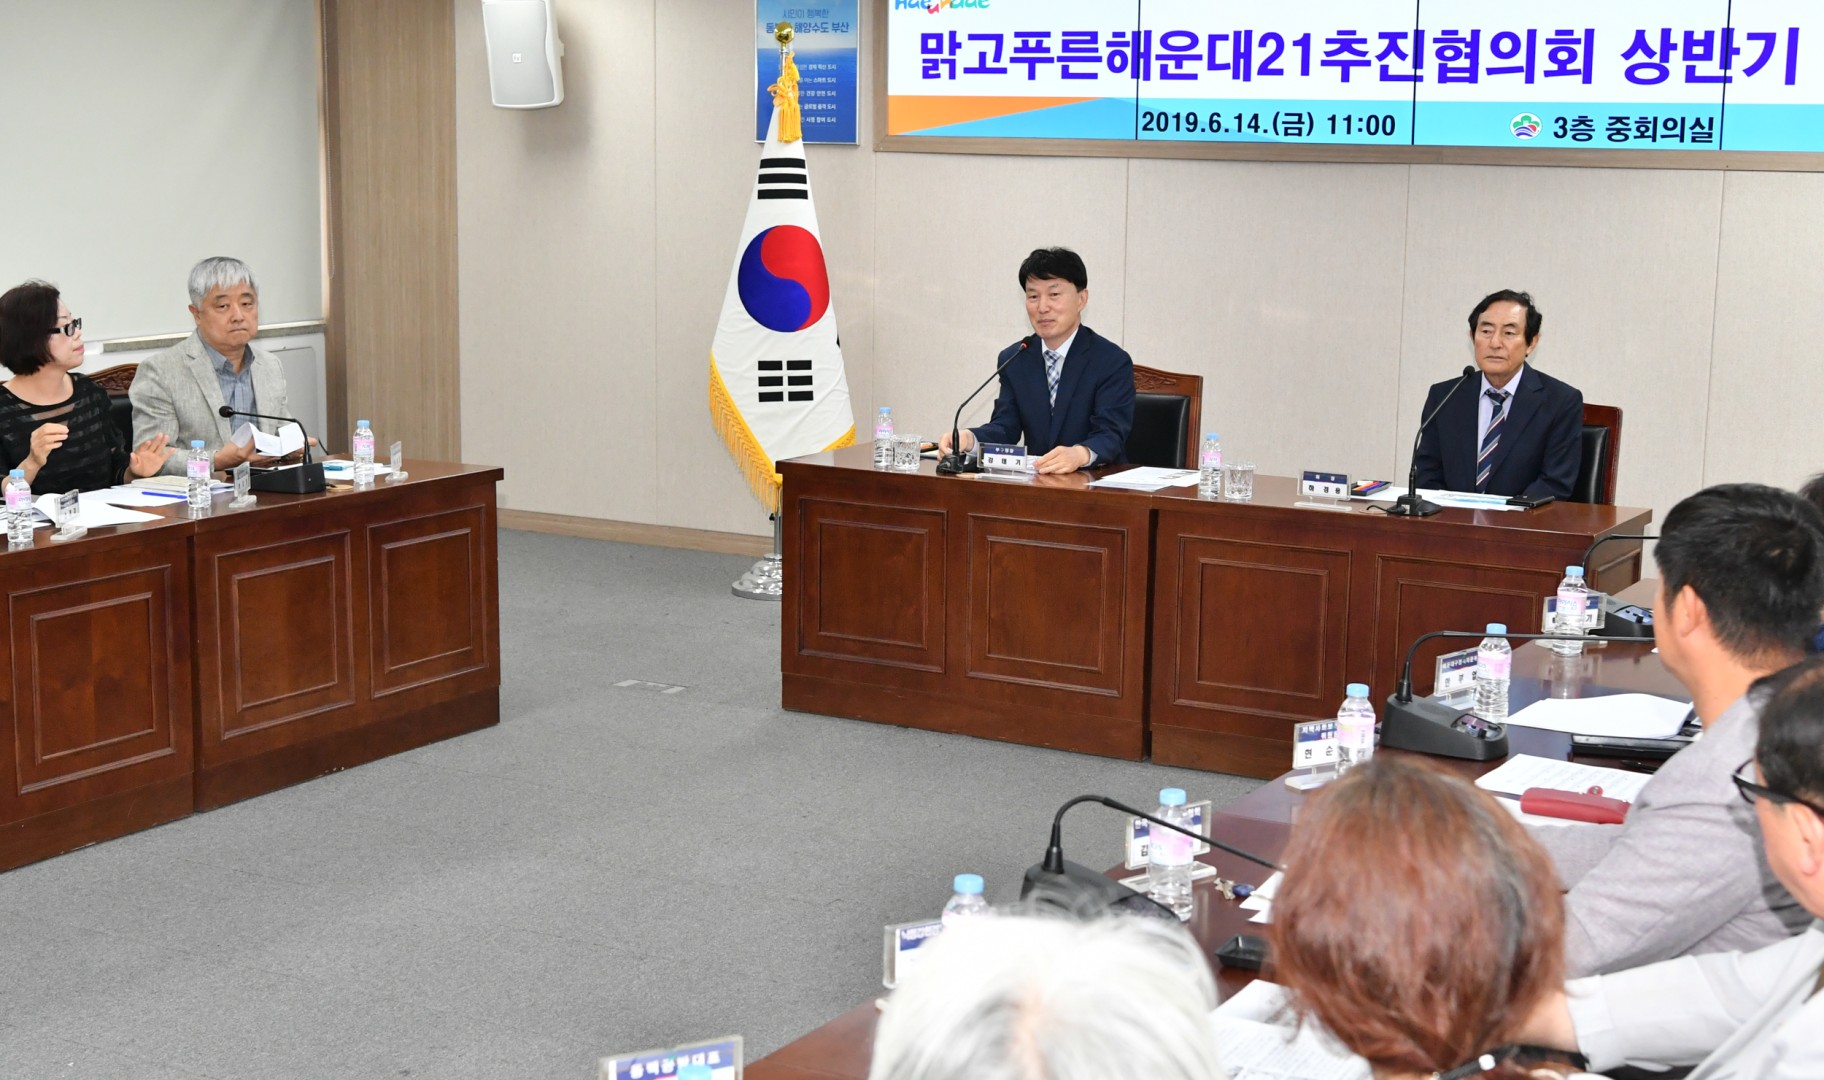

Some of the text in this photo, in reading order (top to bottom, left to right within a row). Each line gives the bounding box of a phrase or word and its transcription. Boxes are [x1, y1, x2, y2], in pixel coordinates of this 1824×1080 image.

[783, 9, 829, 18] 시민이 행복한
[794, 22, 849, 33] 해양수도 부산
[920, 27, 1800, 85] 맑고푸른해운대21추진협의회 상반기
[1142, 111, 1714, 144] 2019.6.14.(금) 11:00 3층 중회의실
